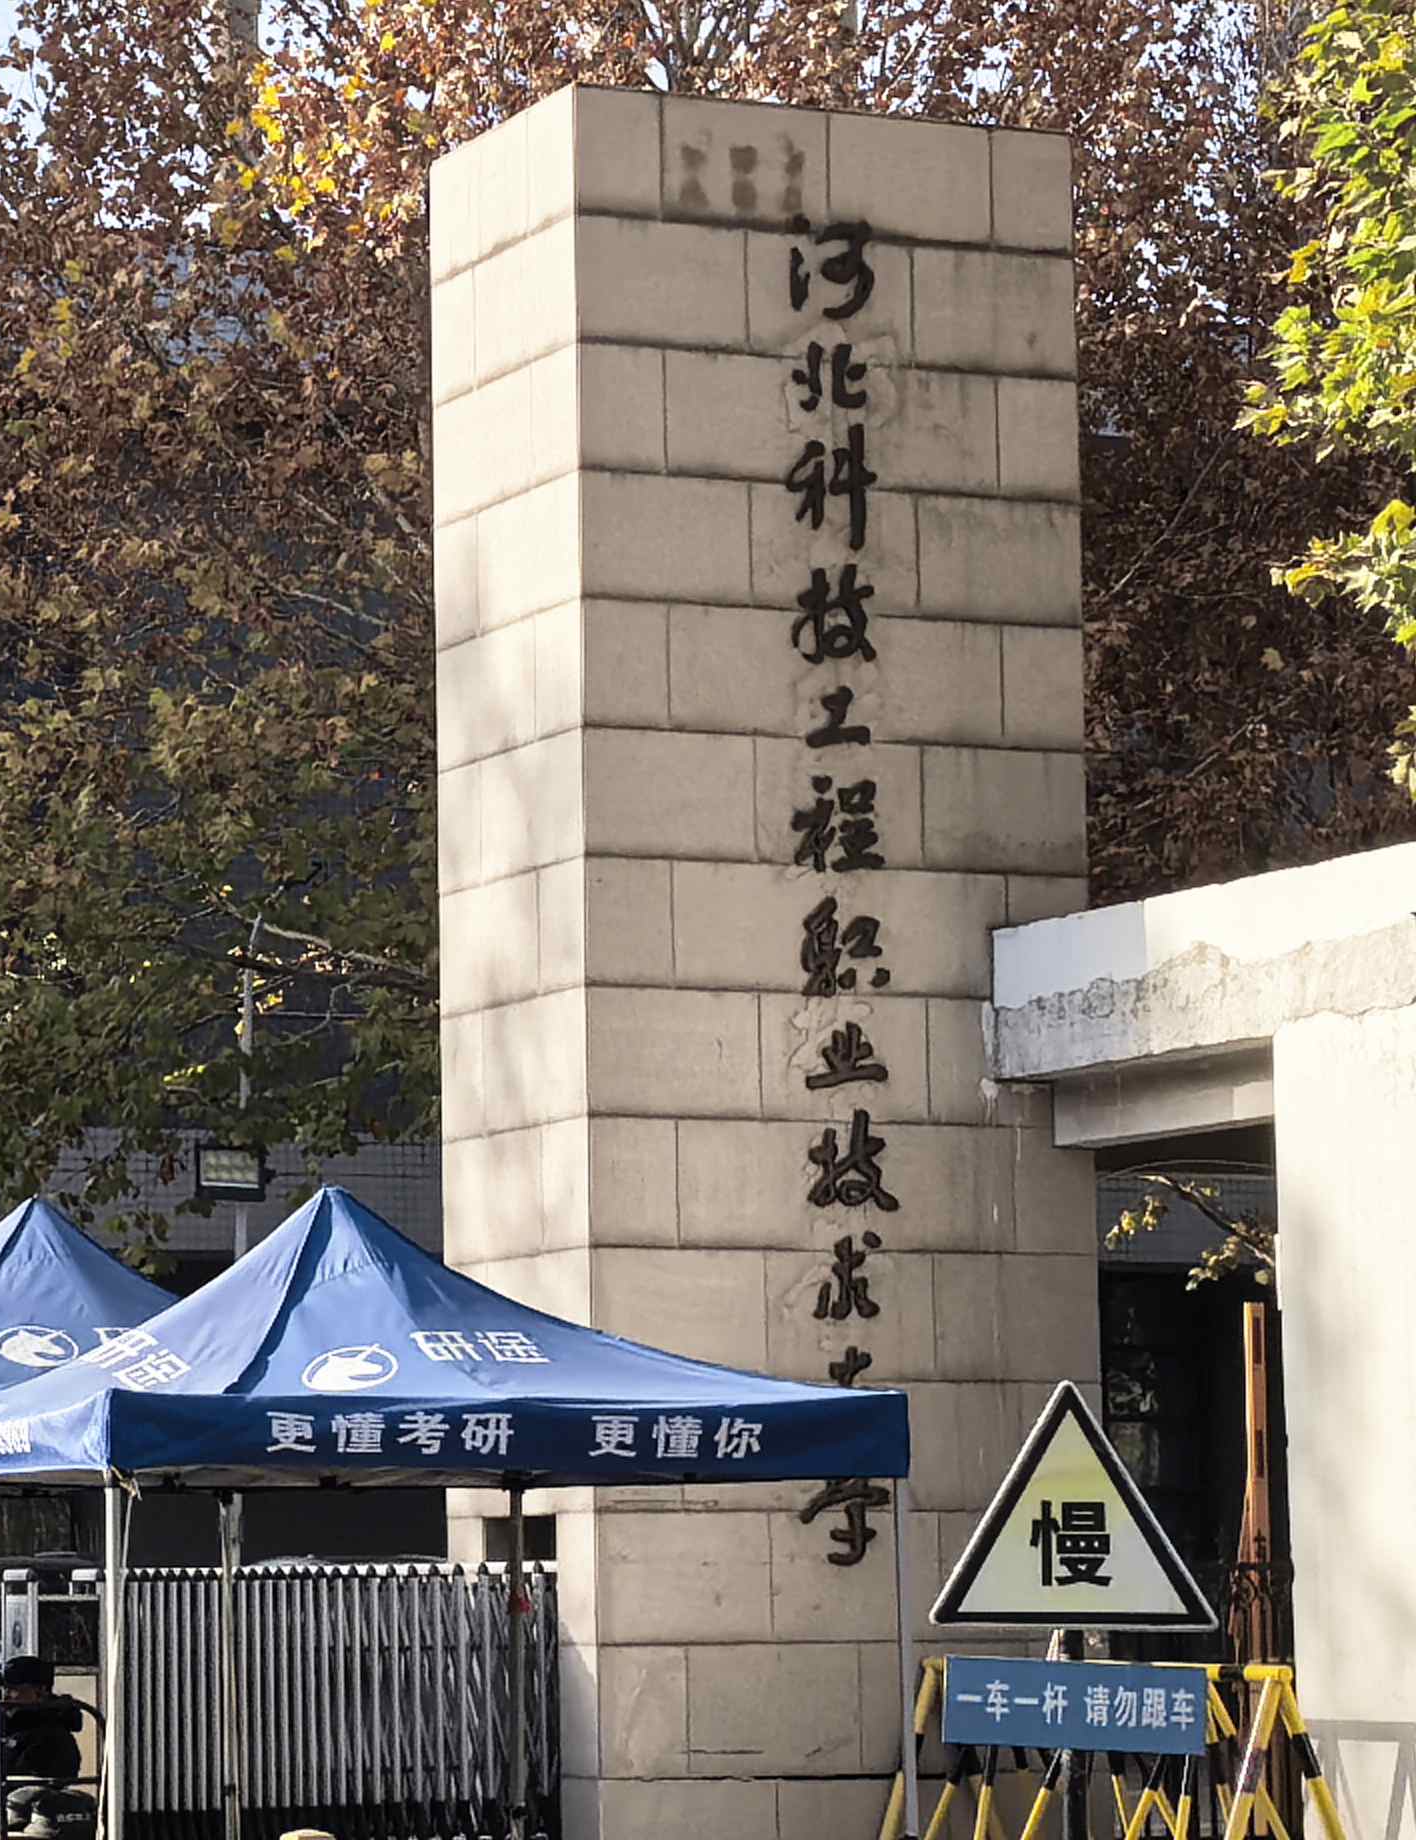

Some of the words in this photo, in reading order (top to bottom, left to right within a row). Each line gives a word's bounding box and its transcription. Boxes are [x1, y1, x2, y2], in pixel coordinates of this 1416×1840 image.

[266, 1411, 514, 1456] 更懂考研
[588, 1415, 763, 1458] 更懂你
[1030, 1500, 1113, 1587] 慢
[956, 1679, 1068, 1725] 一车一杆
[1083, 1684, 1196, 1731] 请勿跟车
